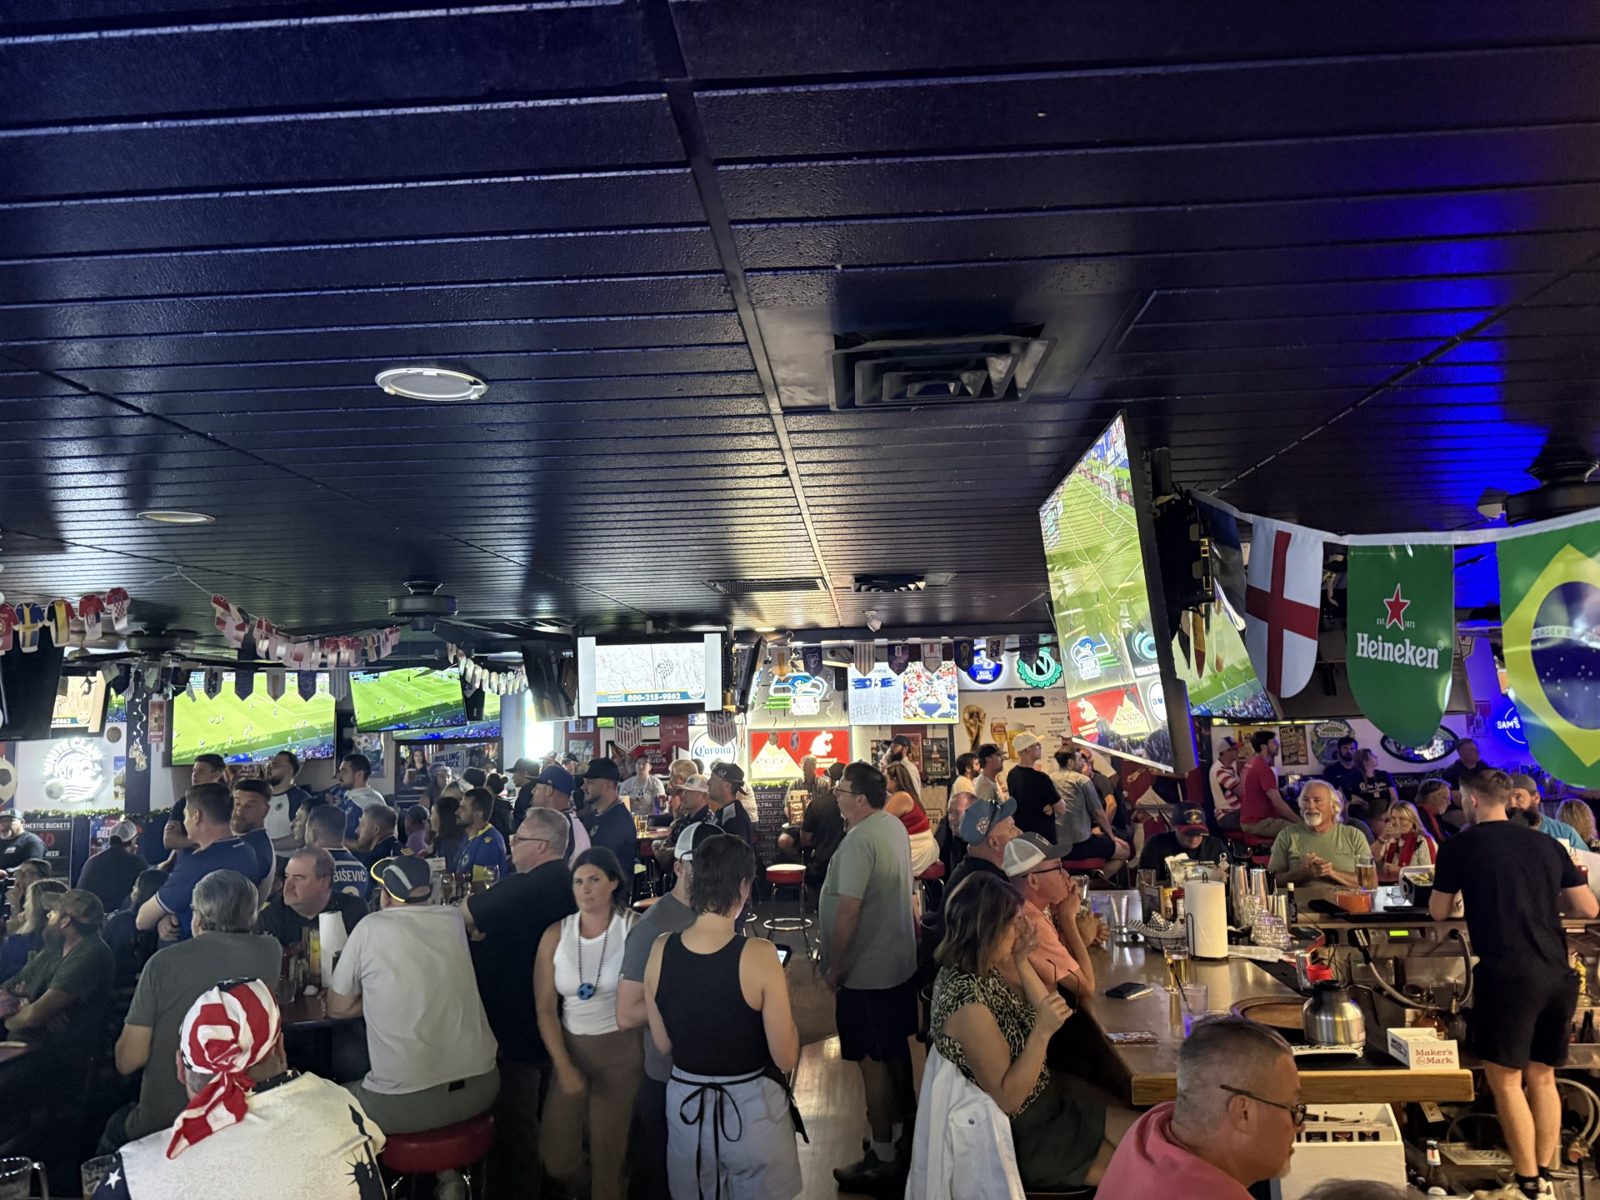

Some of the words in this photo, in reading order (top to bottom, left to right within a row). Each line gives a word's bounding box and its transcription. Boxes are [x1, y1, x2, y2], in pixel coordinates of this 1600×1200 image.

[1356, 632, 1439, 670] Heineken
[1281, 726, 1294, 735] NEW
[694, 746, 731, 758] Corona
[1415, 1049, 1453, 1057] Maker's
